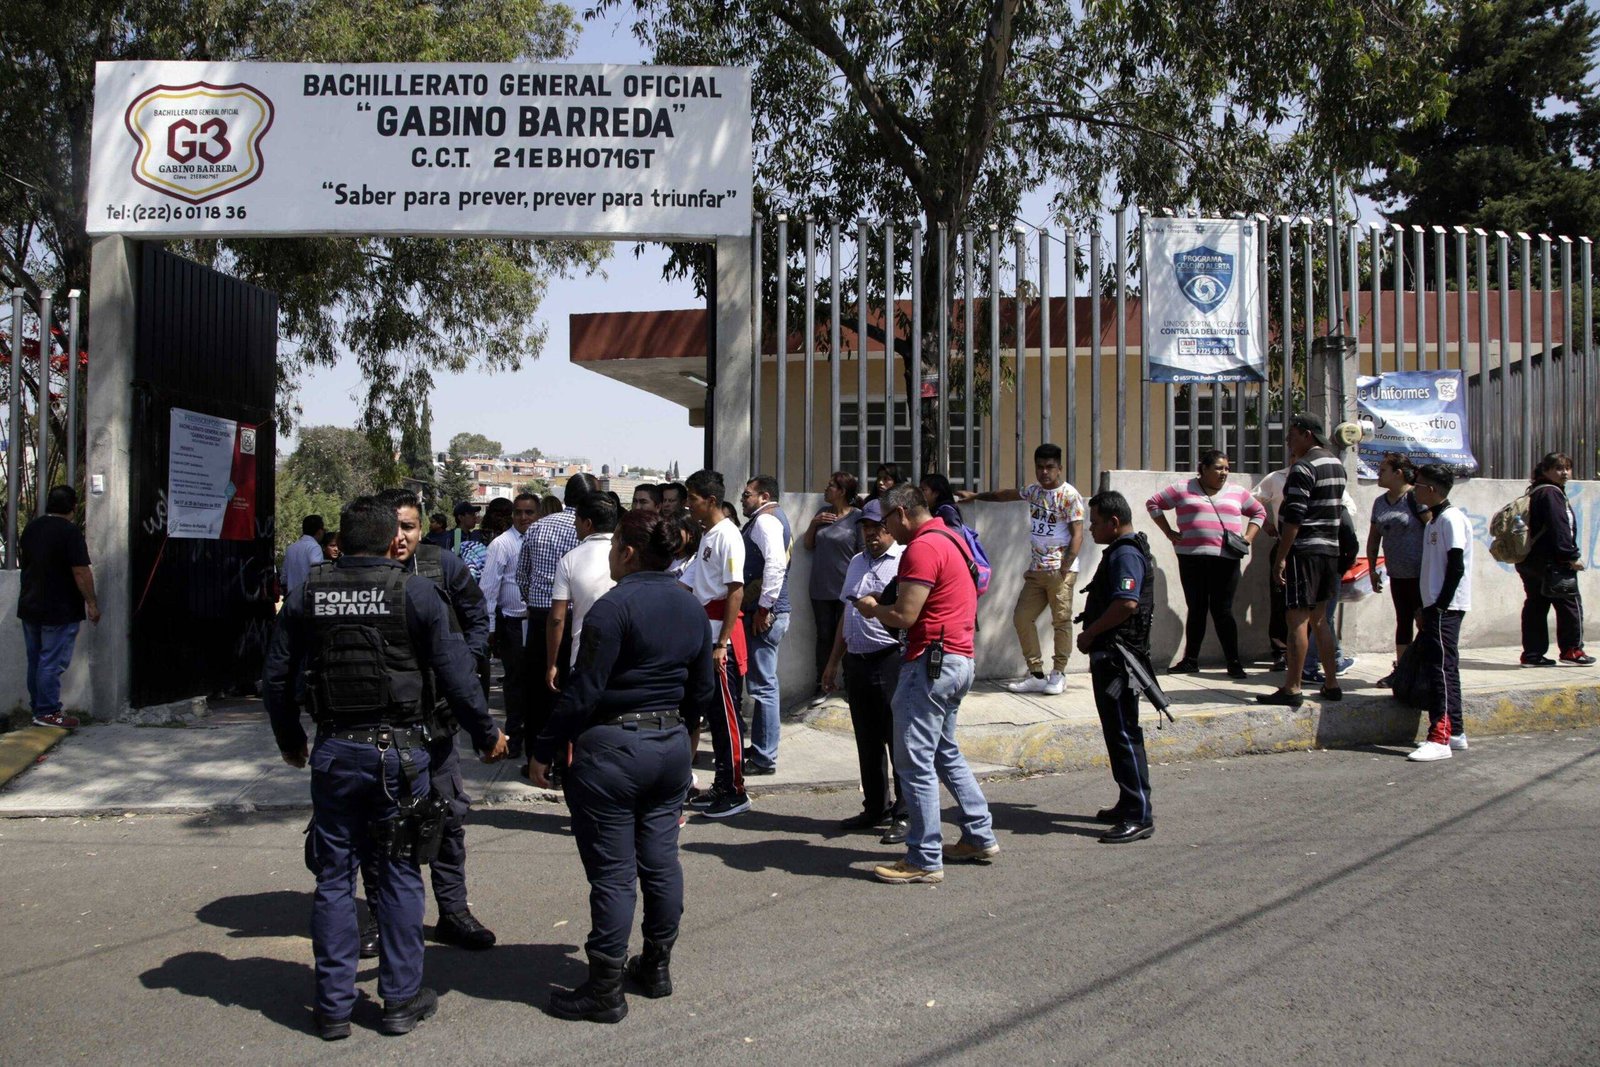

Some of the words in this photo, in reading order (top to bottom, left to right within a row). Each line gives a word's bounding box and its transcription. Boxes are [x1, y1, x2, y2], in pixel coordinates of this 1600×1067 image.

[304, 74, 488, 96] BACHILLERATO
[500, 73, 612, 97] GENERAL
[623, 74, 722, 99] OFICIAL
[153, 109, 198, 117] BACHILLERATO
[220, 108, 239, 116] OFICIAL
[167, 117, 232, 164] G3
[411, 147, 471, 168] C.C.T.
[158, 165, 195, 173] GABINO
[197, 164, 238, 173] BARREDA
[404, 190, 450, 211] para
[458, 190, 529, 211] prever,
[533, 190, 596, 211] prever
[602, 190, 643, 212] para
[1183, 255, 1223, 263] PROGRAMA
[1176, 262, 1205, 270] COLONO
[1205, 262, 1231, 270] ALERTA
[1163, 320, 1188, 328] UNIDOS
[1160, 327, 1189, 335] CONTRA
[1190, 327, 1200, 335] LA
[1201, 327, 1250, 336] DELINCUENCIA
[1370, 385, 1430, 400] Uniformes
[314, 603, 391, 616] ESTATAL
